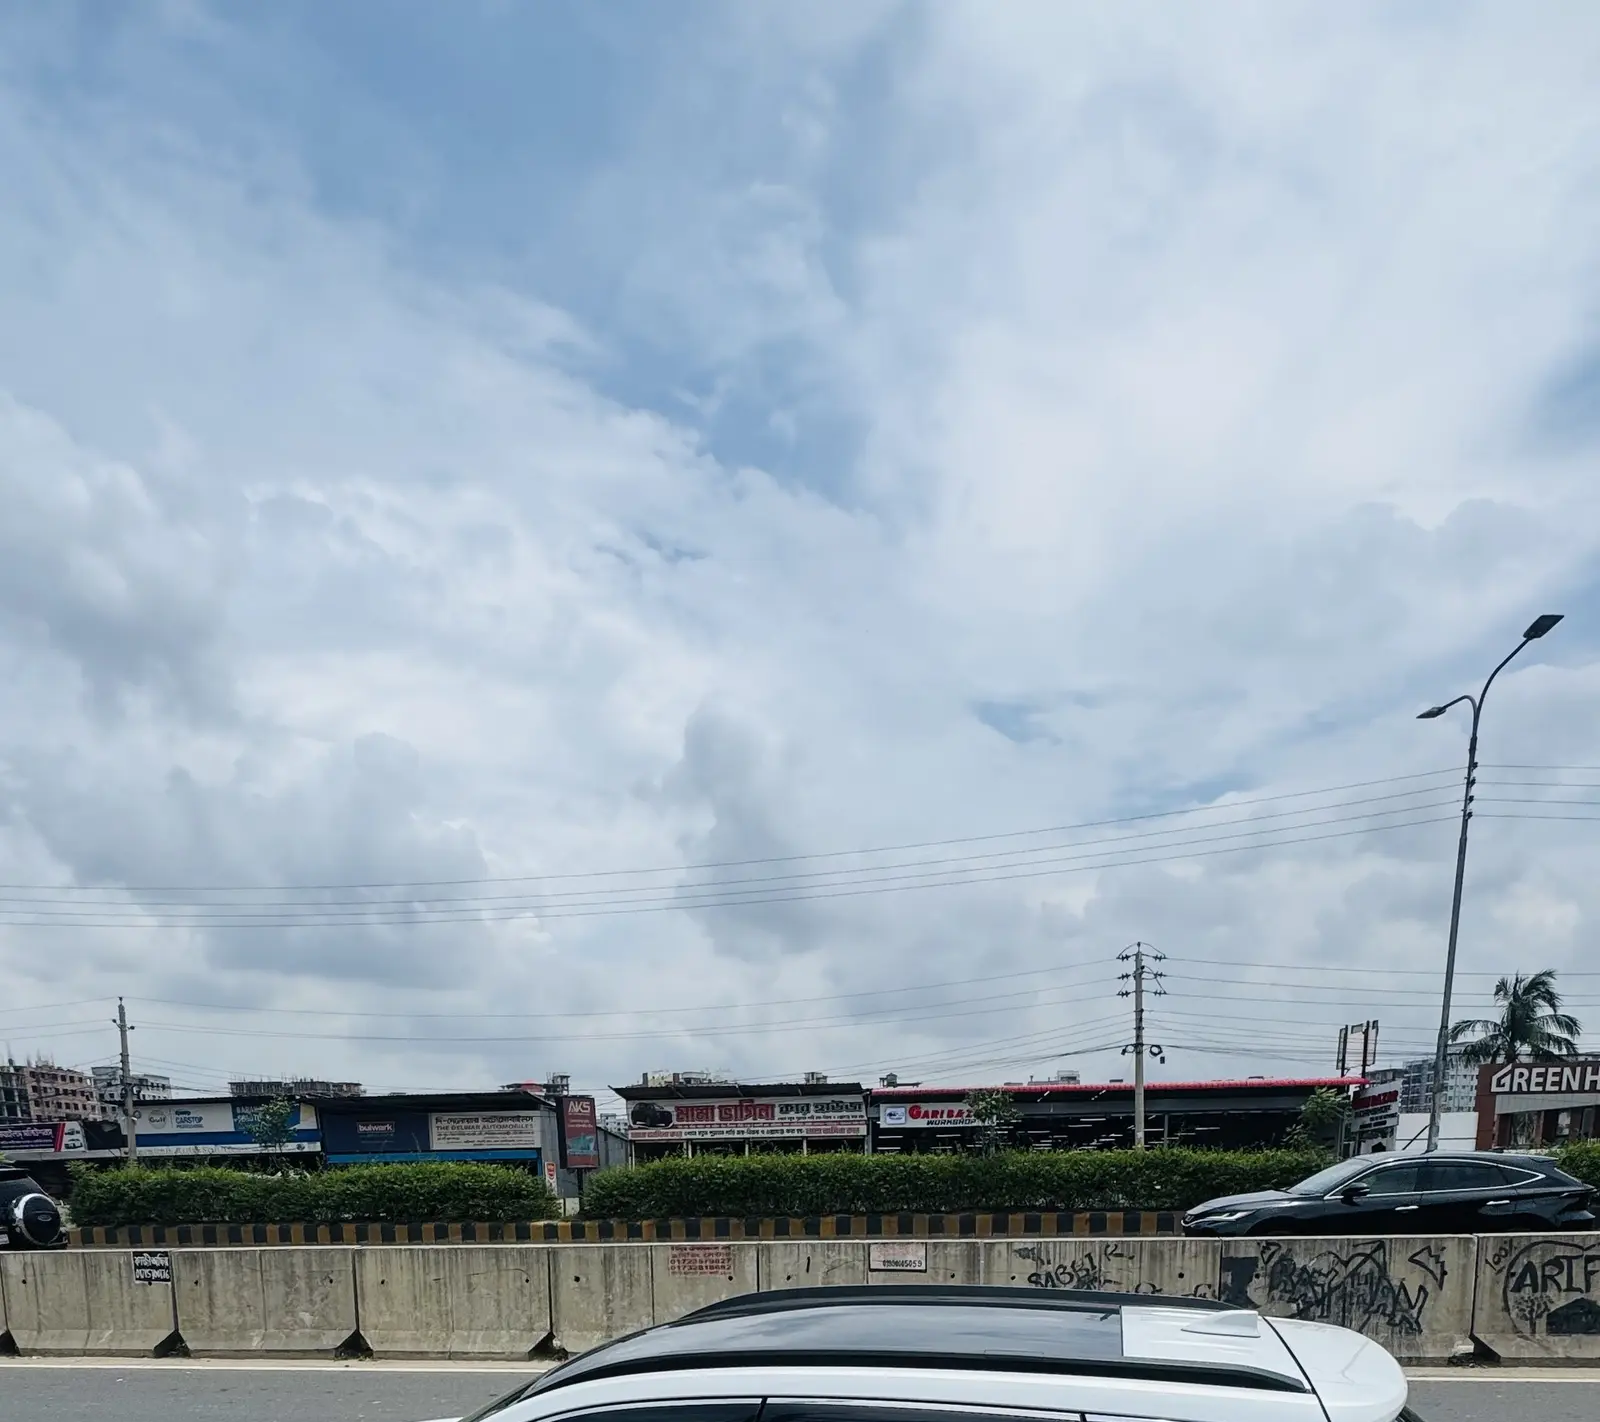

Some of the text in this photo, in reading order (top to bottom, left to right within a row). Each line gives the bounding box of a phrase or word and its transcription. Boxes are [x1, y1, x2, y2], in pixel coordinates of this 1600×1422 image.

[568, 1101, 591, 1112] AKS
[674, 1105, 716, 1122] মামা
[718, 1099, 775, 1121] ভাগিনা
[778, 1103, 811, 1116] কার
[908, 1105, 944, 1119] GARI
[175, 1116, 203, 1124] CARSTOP
